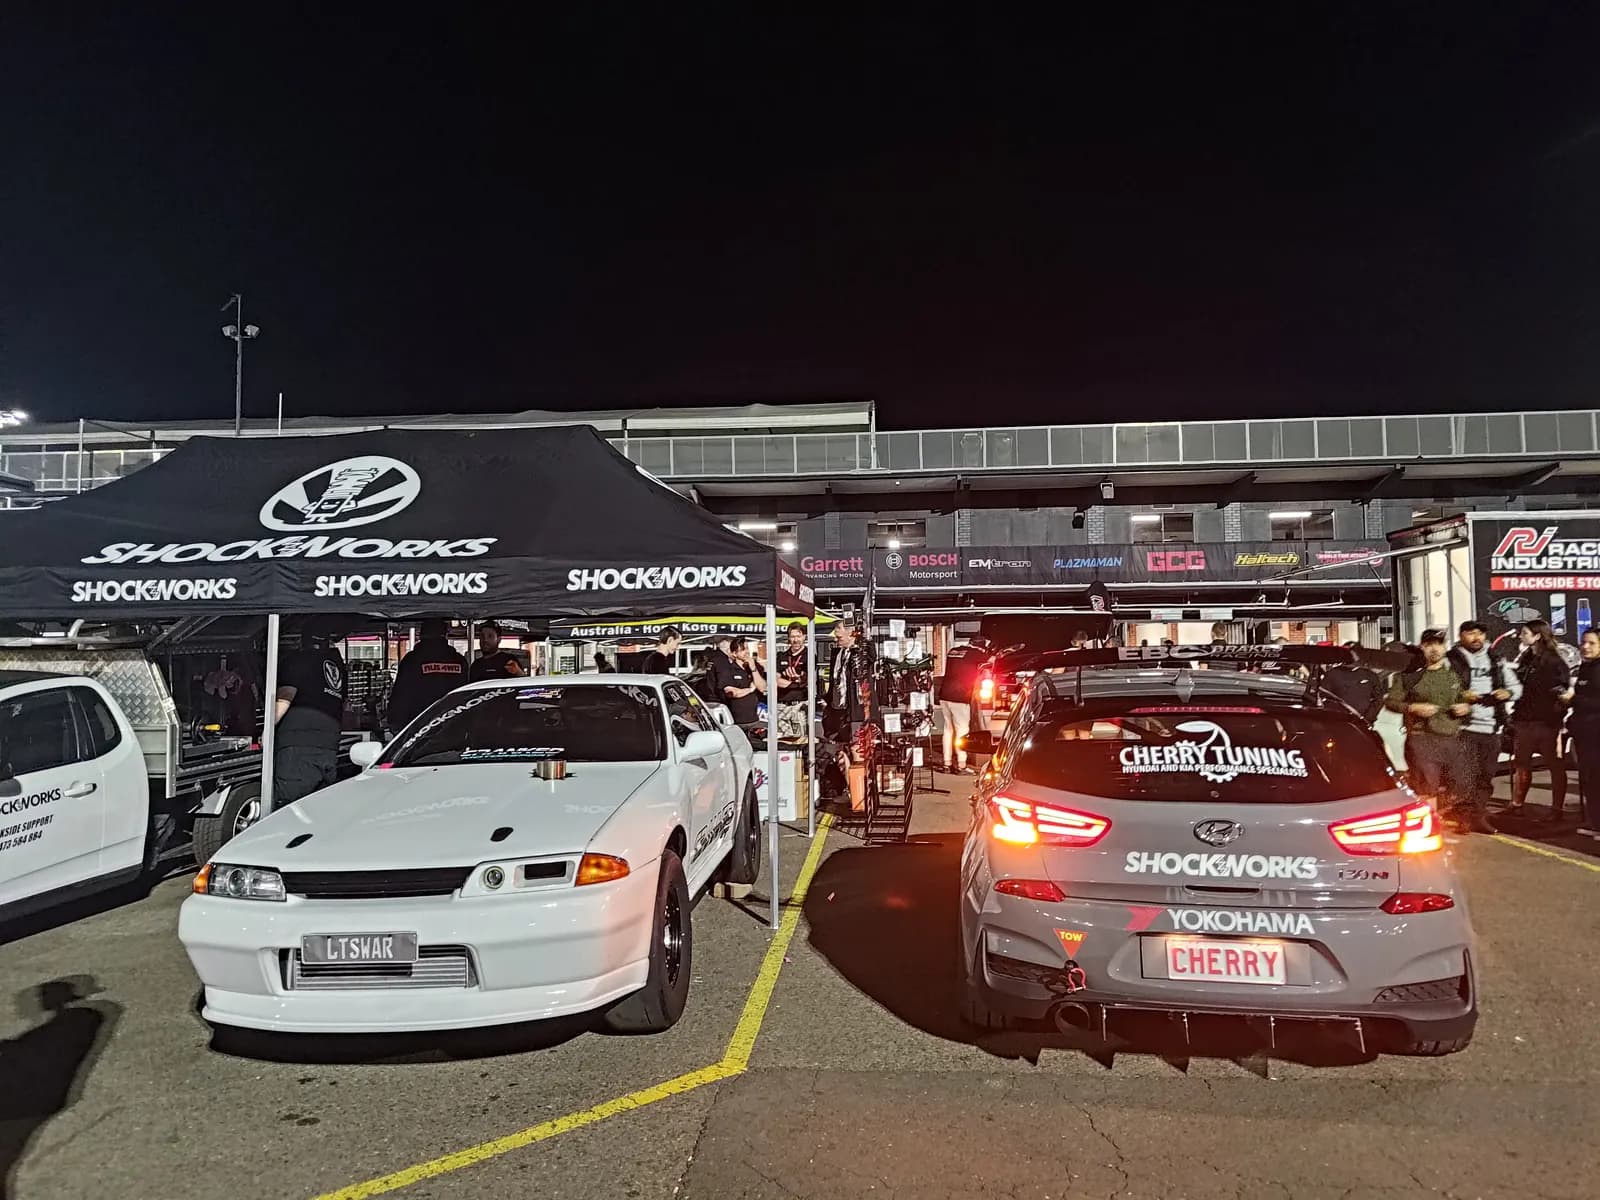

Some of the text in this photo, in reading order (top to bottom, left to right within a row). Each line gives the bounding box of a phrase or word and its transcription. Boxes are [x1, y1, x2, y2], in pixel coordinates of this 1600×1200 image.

[81, 535, 498, 564] SHOCKWORKS
[1235, 552, 1298, 566] Haltech
[801, 556, 864, 572] Garrett
[909, 554, 957, 567] BOSCH
[1054, 557, 1123, 568] PLAZMAMAN
[1147, 550, 1205, 571] GCG
[1491, 556, 1600, 570] INDUSTRI
[315, 572, 488, 597] SHOCKWORKS
[566, 565, 747, 592] SHOCKWORKS
[909, 570, 958, 580] Motorsport
[1502, 577, 1575, 589] TRACKSIDE
[71, 578, 238, 602] SHOCKWORKS
[570, 626, 632, 637] Australia
[643, 624, 678, 635] Ho
[682, 622, 718, 634] Kong
[730, 623, 788, 633] Thaild
[1119, 745, 1306, 769] CHERRY TUNING
[1122, 763, 1308, 777] HYUNDAI AND KIA PERFORMANCE SPECIALISTS
[0, 788, 61, 815] CKWORKS
[22, 814, 54, 832] SUPPORT
[1124, 851, 1319, 880] SHOCKWORKS
[1167, 908, 1315, 935] YOKOHAMA
[1060, 931, 1083, 942] TOW
[326, 937, 394, 960] LTSWAR
[1172, 947, 1278, 977] CHERRY
